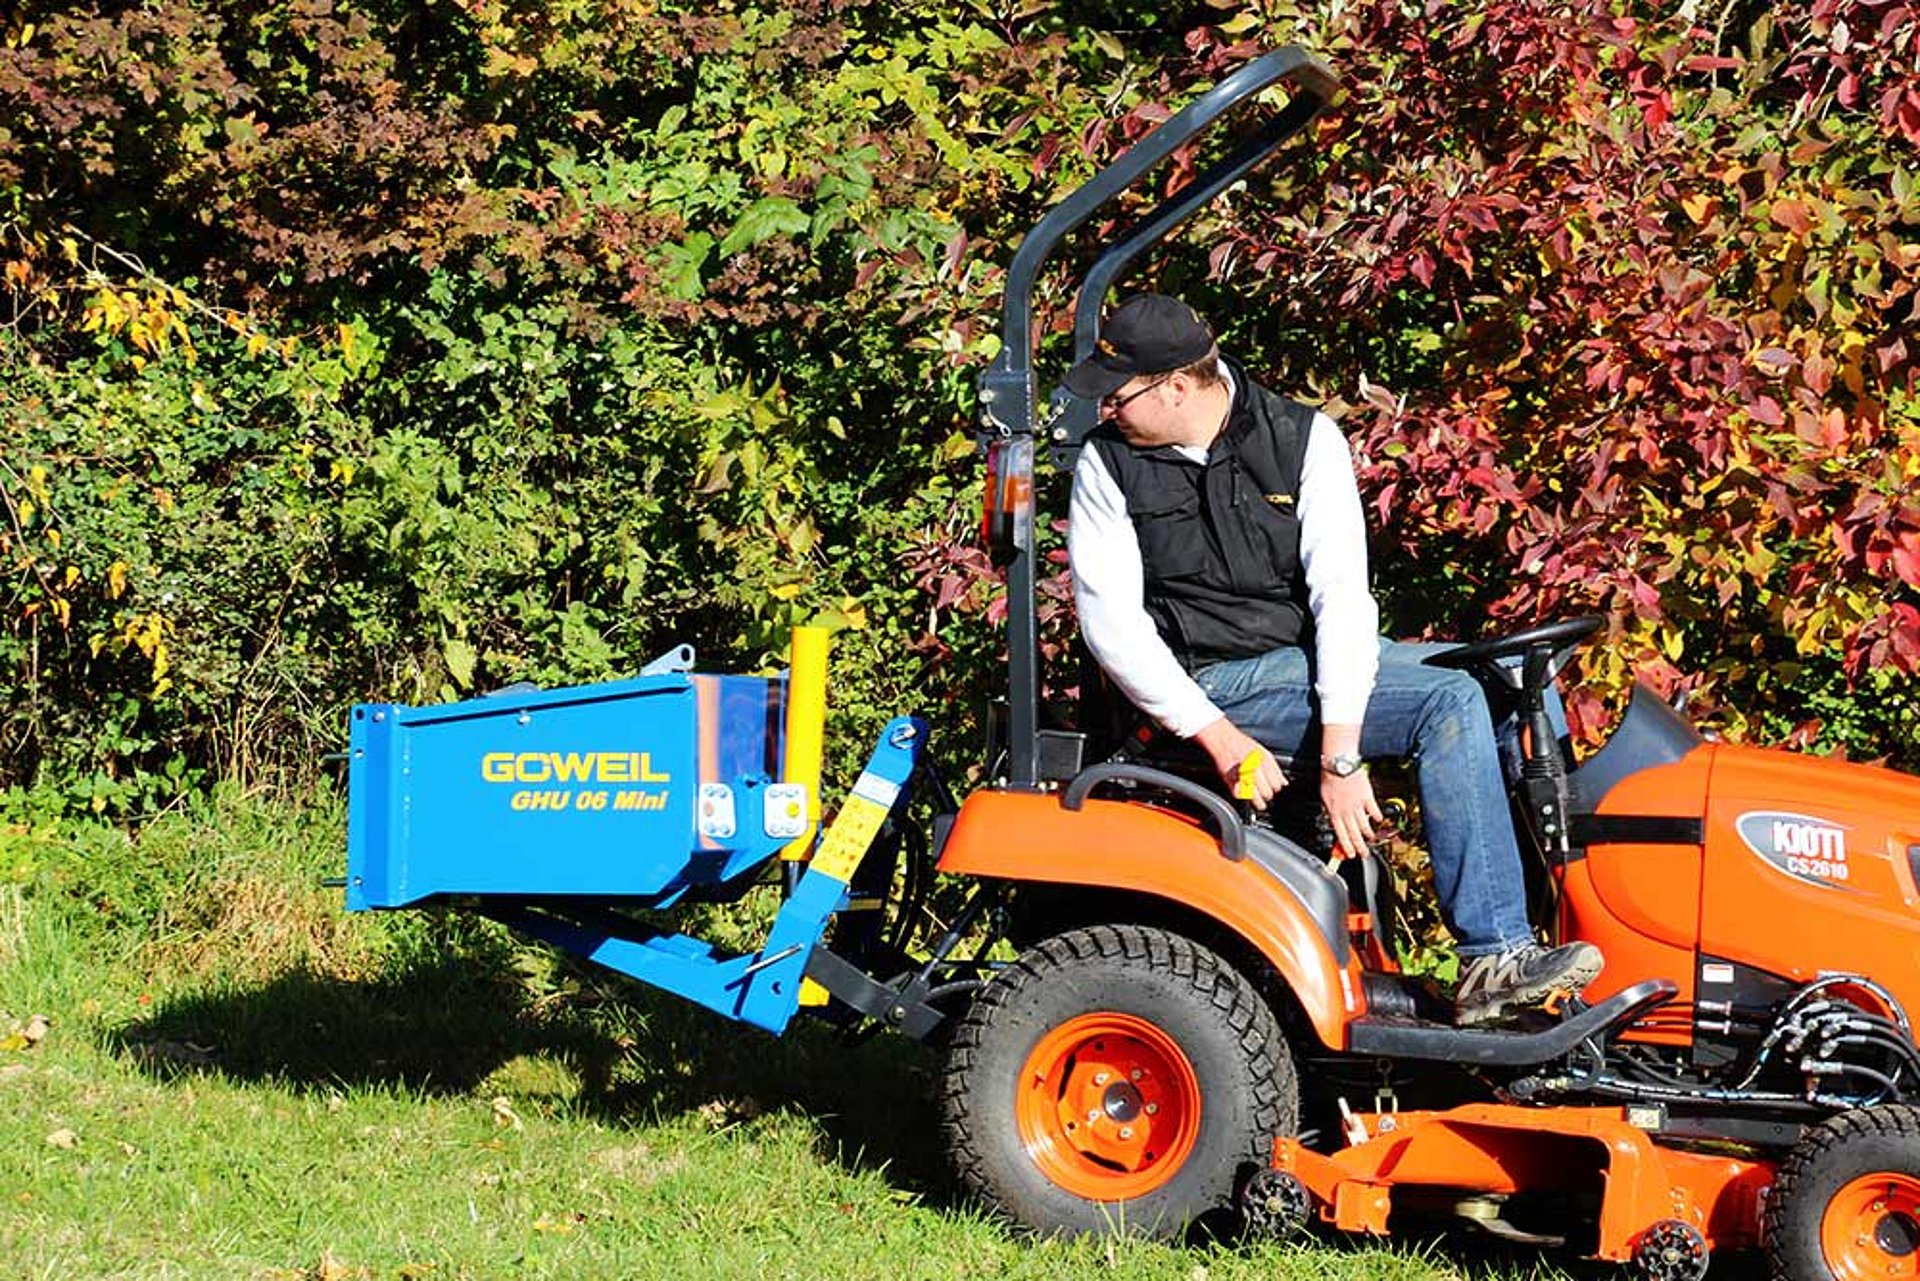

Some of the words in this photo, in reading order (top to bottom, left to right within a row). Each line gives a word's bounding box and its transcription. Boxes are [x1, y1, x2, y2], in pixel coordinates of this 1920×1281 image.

[511, 790, 571, 811] GHU
[575, 790, 609, 811] 06
[613, 790, 669, 811] Mini
[1773, 821, 1845, 861] KIOTI
